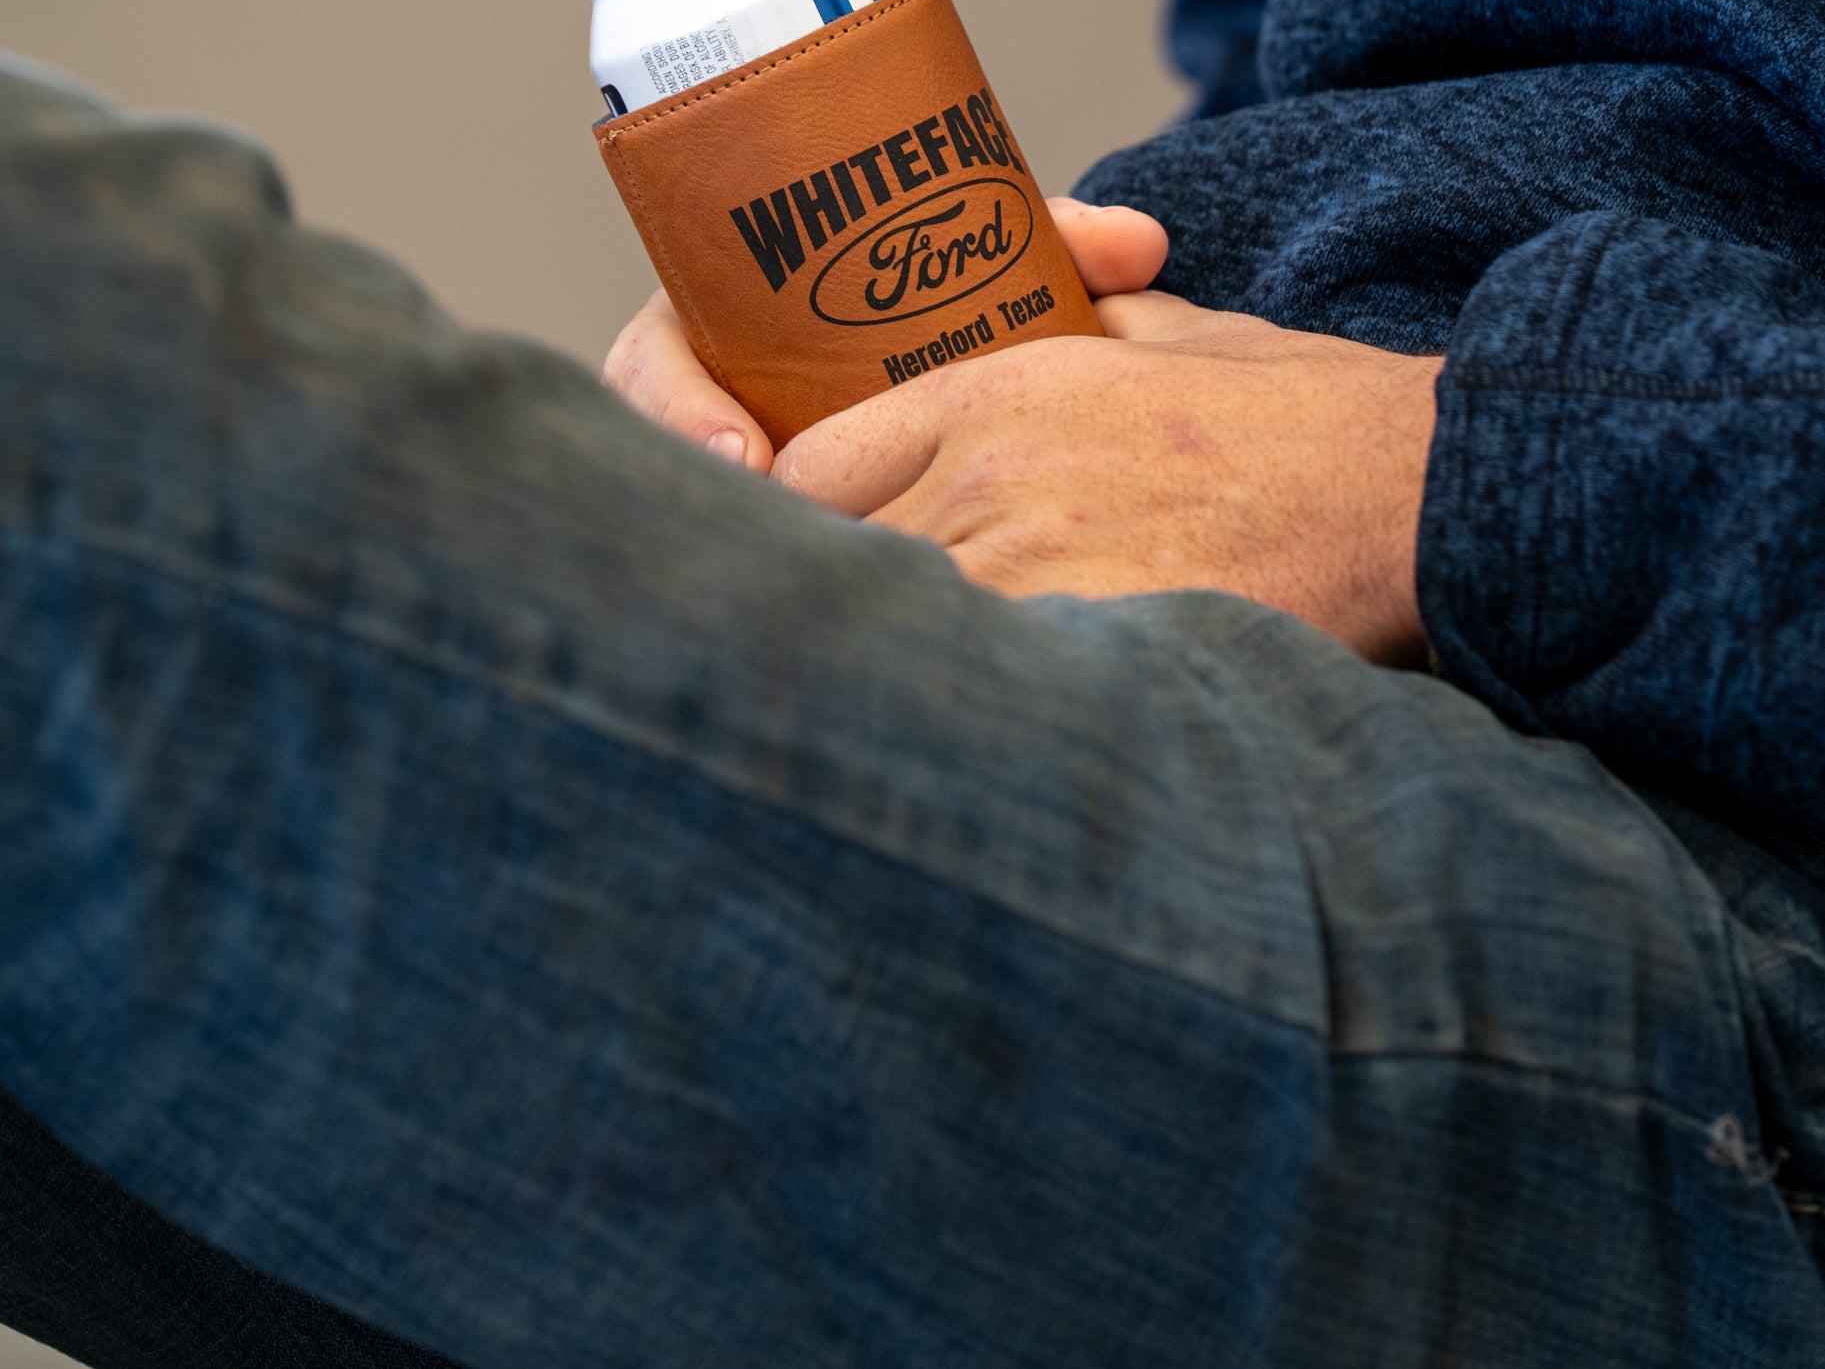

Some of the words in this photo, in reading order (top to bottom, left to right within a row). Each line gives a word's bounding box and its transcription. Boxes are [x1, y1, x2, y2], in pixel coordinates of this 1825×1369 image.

[652, 43, 668, 68] SHOU
[682, 50, 695, 62] OF
[705, 29, 728, 62] ABILITY
[641, 52, 667, 94] ACCORDING
[688, 61, 705, 81] RISK
[703, 64, 717, 74] OF
[729, 87, 1026, 293] WHITEFACE
[864, 198, 1012, 311] Ford
[882, 313, 995, 385] Hereford
[997, 284, 1055, 331] Texas
